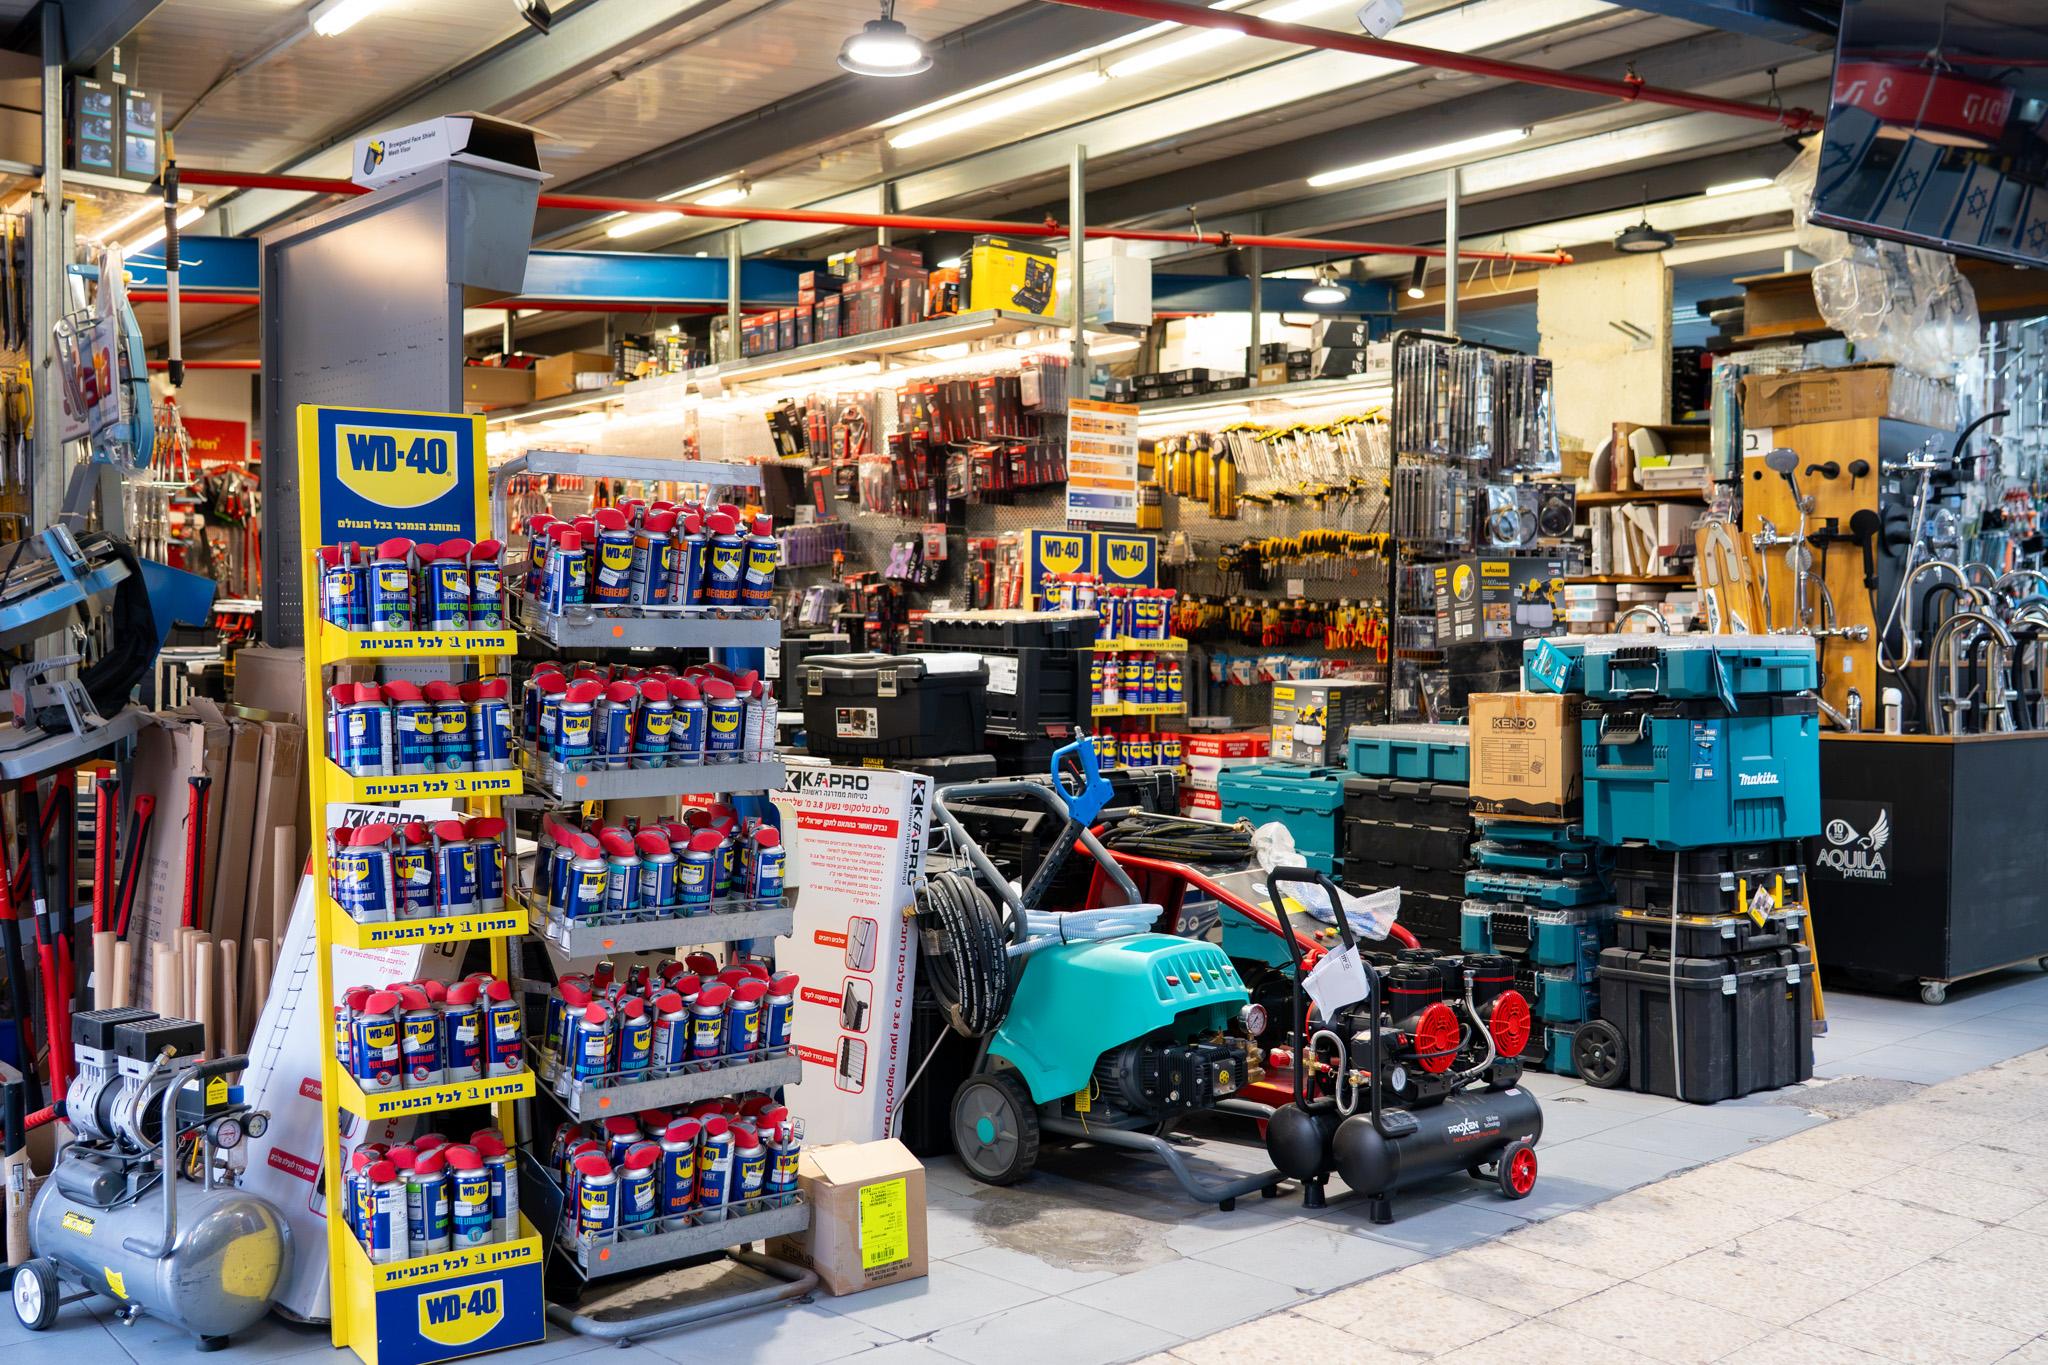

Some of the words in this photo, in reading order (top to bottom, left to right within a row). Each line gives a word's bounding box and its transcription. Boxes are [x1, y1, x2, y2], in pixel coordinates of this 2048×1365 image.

[388, 138, 411, 149] Browguard
[411, 135, 422, 144] Face
[422, 131, 436, 140] Shield
[388, 148, 400, 157] Mesh
[346, 433, 448, 475] WD-40
[337, 518, 371, 529] העולם
[373, 519, 393, 530] בכל
[394, 521, 427, 531] הנמכר
[428, 523, 461, 532] המותג
[606, 546, 632, 559] WD-40
[1045, 540, 1079, 559] WD-40
[1111, 543, 1144, 562] WD-40
[360, 639, 414, 649] הבעיות
[417, 636, 443, 648] לכל
[466, 637, 505, 649] פתרון
[440, 713, 465, 724] WD-40
[566, 717, 590, 729] WD-40
[714, 712, 738, 724] WD-40
[1492, 717, 1536, 729] KENDO
[423, 780, 449, 792] לכל
[472, 779, 511, 791] פתרון
[802, 771, 869, 791] KAPRO
[365, 783, 419, 795] הבעיות
[688, 794, 697, 802] EN
[813, 800, 824, 809] 3.8
[824, 801, 841, 812] נשען
[842, 803, 871, 814] טלסקופי
[872, 805, 890, 815] סולם
[1832, 823, 1844, 834] 10
[1815, 848, 1886, 872] AQUILA
[1843, 868, 1887, 880] premium
[428, 922, 454, 936] לכל
[477, 919, 516, 932] פתרון
[371, 929, 425, 941] הבעיות
[896, 954, 906, 993] שלבים
[892, 1012, 901, 1030] 3.8
[368, 1027, 394, 1040] WD-40
[406, 1022, 432, 1035] WD-40
[889, 1033, 899, 1061] נשען
[485, 1081, 524, 1098] פתרון
[436, 1090, 462, 1104] לכל
[378, 1096, 432, 1112] הבעיות
[1447, 1117, 1480, 1136] PROXEN
[462, 1185, 487, 1197] WD-40
[582, 1191, 606, 1203] WD-40
[491, 1247, 531, 1264] פתרון
[442, 1256, 469, 1271] לכל
[386, 1265, 439, 1282] הבעיות
[425, 1286, 497, 1326] WD-40
